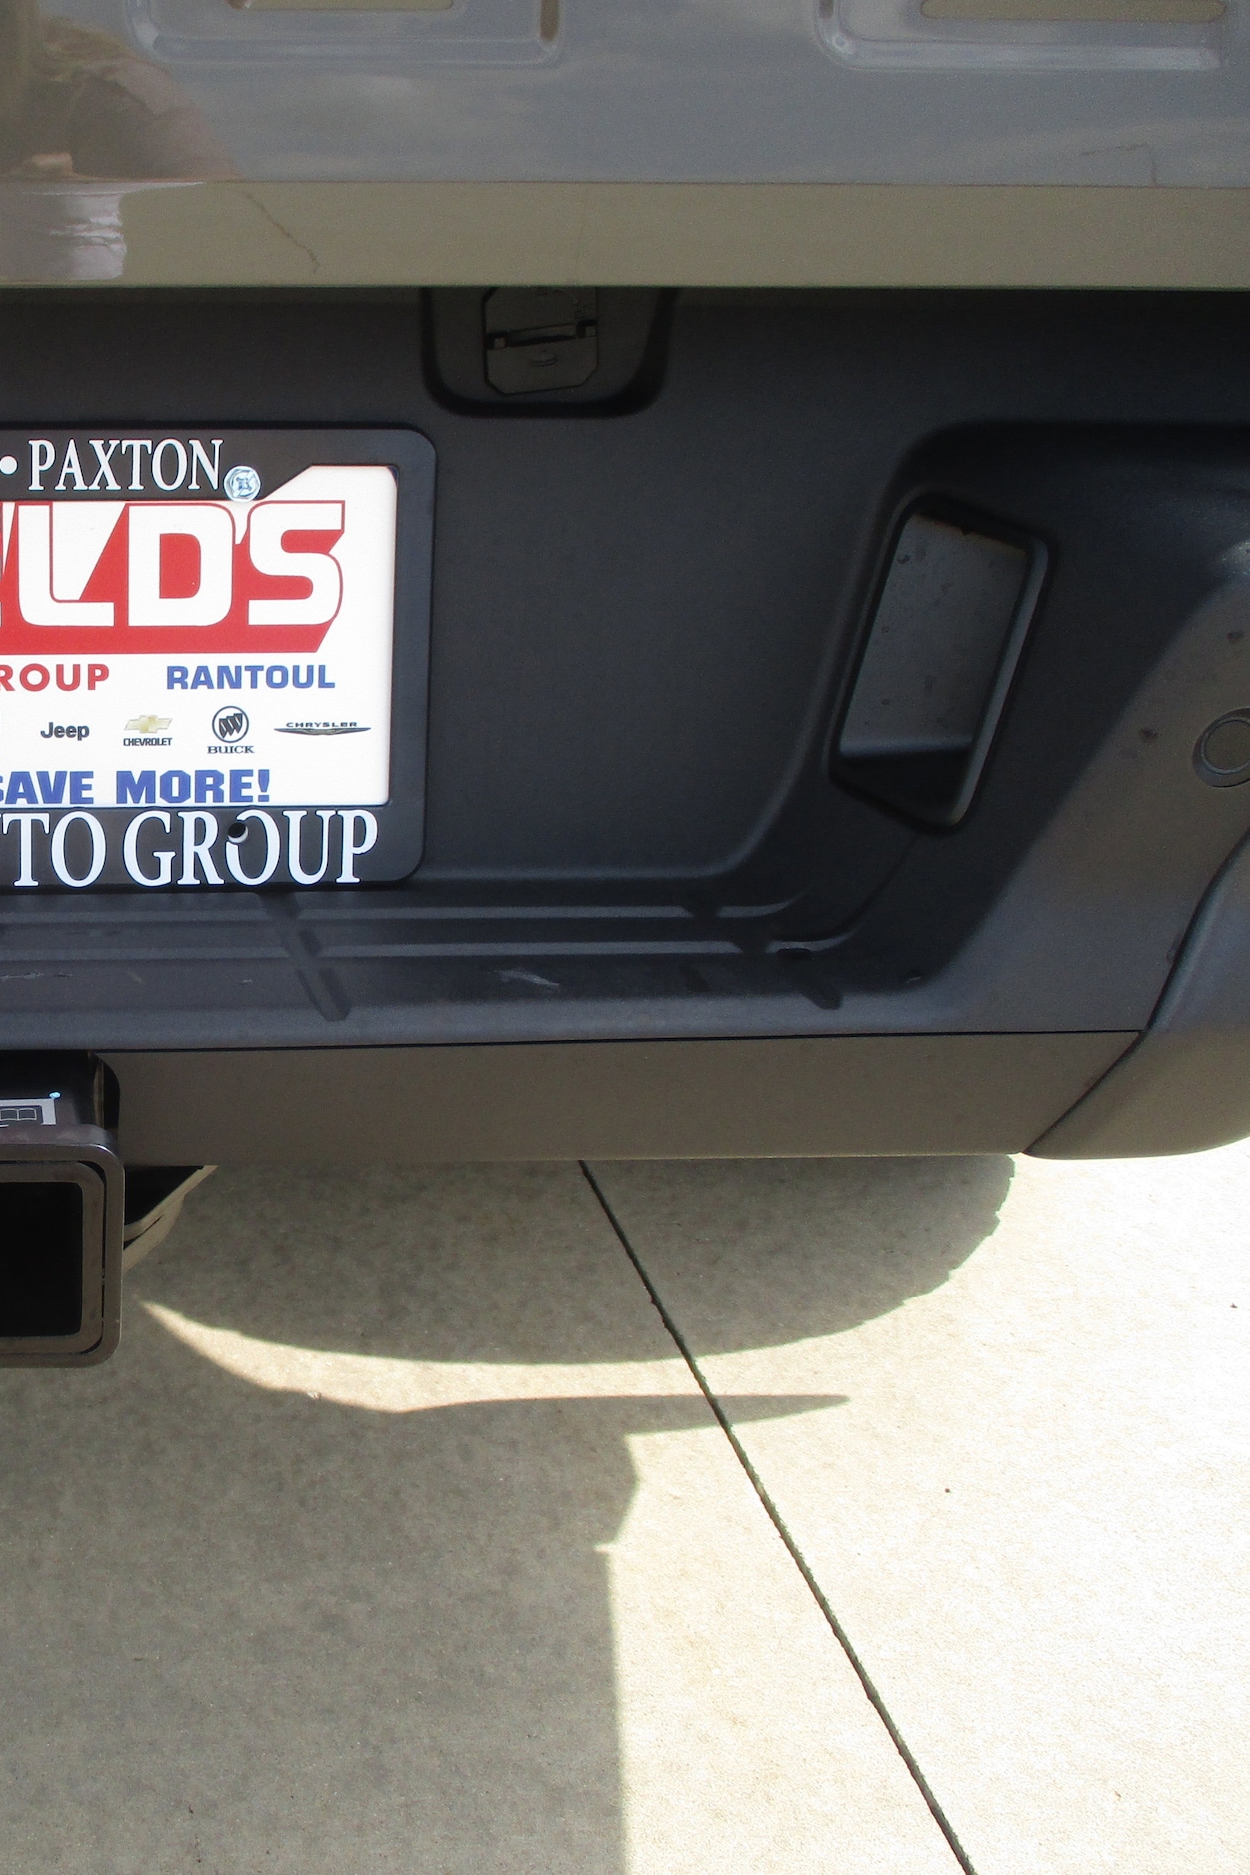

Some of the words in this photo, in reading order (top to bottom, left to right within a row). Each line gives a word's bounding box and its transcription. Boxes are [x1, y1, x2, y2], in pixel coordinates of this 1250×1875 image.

[28, 438, 224, 491] PAXTON
[167, 665, 335, 690] RANTOUL
[40, 721, 90, 741] Jeep
[123, 737, 173, 747] CHEVROLET
[206, 745, 255, 755] BUICK
[116, 769, 270, 804] MORE!
[122, 808, 378, 886] GROUP
